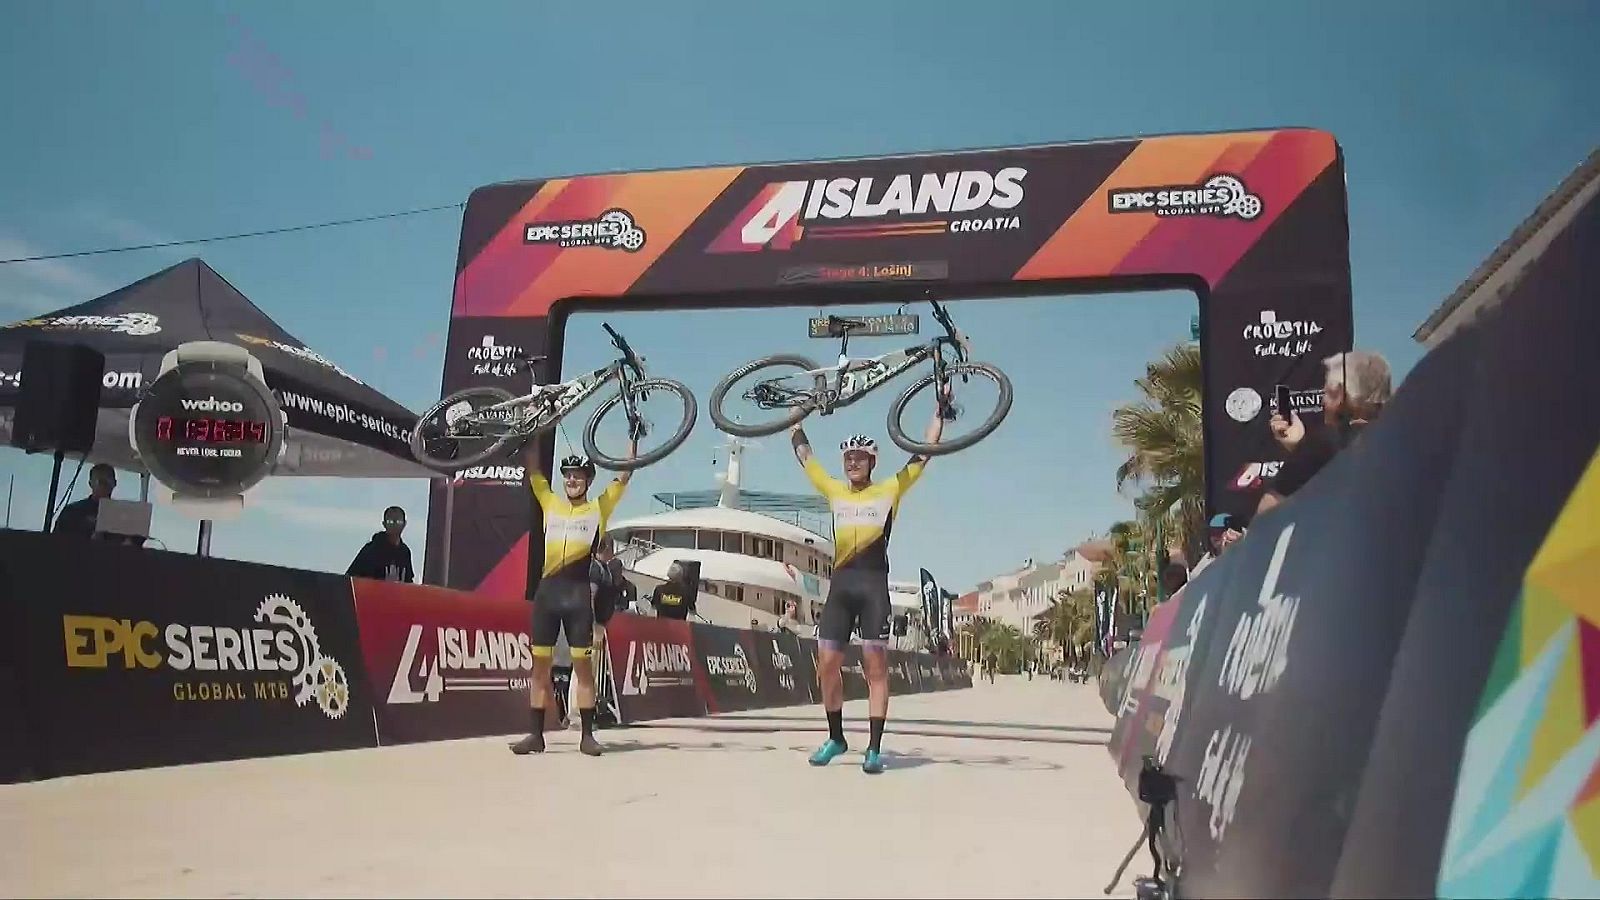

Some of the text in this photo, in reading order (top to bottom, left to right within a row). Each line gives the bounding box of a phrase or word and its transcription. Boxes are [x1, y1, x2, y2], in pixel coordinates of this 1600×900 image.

[804, 167, 1027, 220] ISLANDS
[1113, 187, 1229, 210] EPIC SERIES
[527, 221, 620, 241] EPIC SERIES
[950, 216, 1020, 234] CROATIA
[1243, 320, 1324, 340] CROATIA
[467, 346, 523, 360] CROATI
[181, 396, 244, 412] wahoo
[464, 466, 525, 480] ISLANDS
[63, 614, 299, 672] EPIC SERIES
[437, 626, 533, 671] ISLANDS
[643, 642, 692, 672] ISLANDS
[173, 680, 289, 701] GLOBAL MTB
